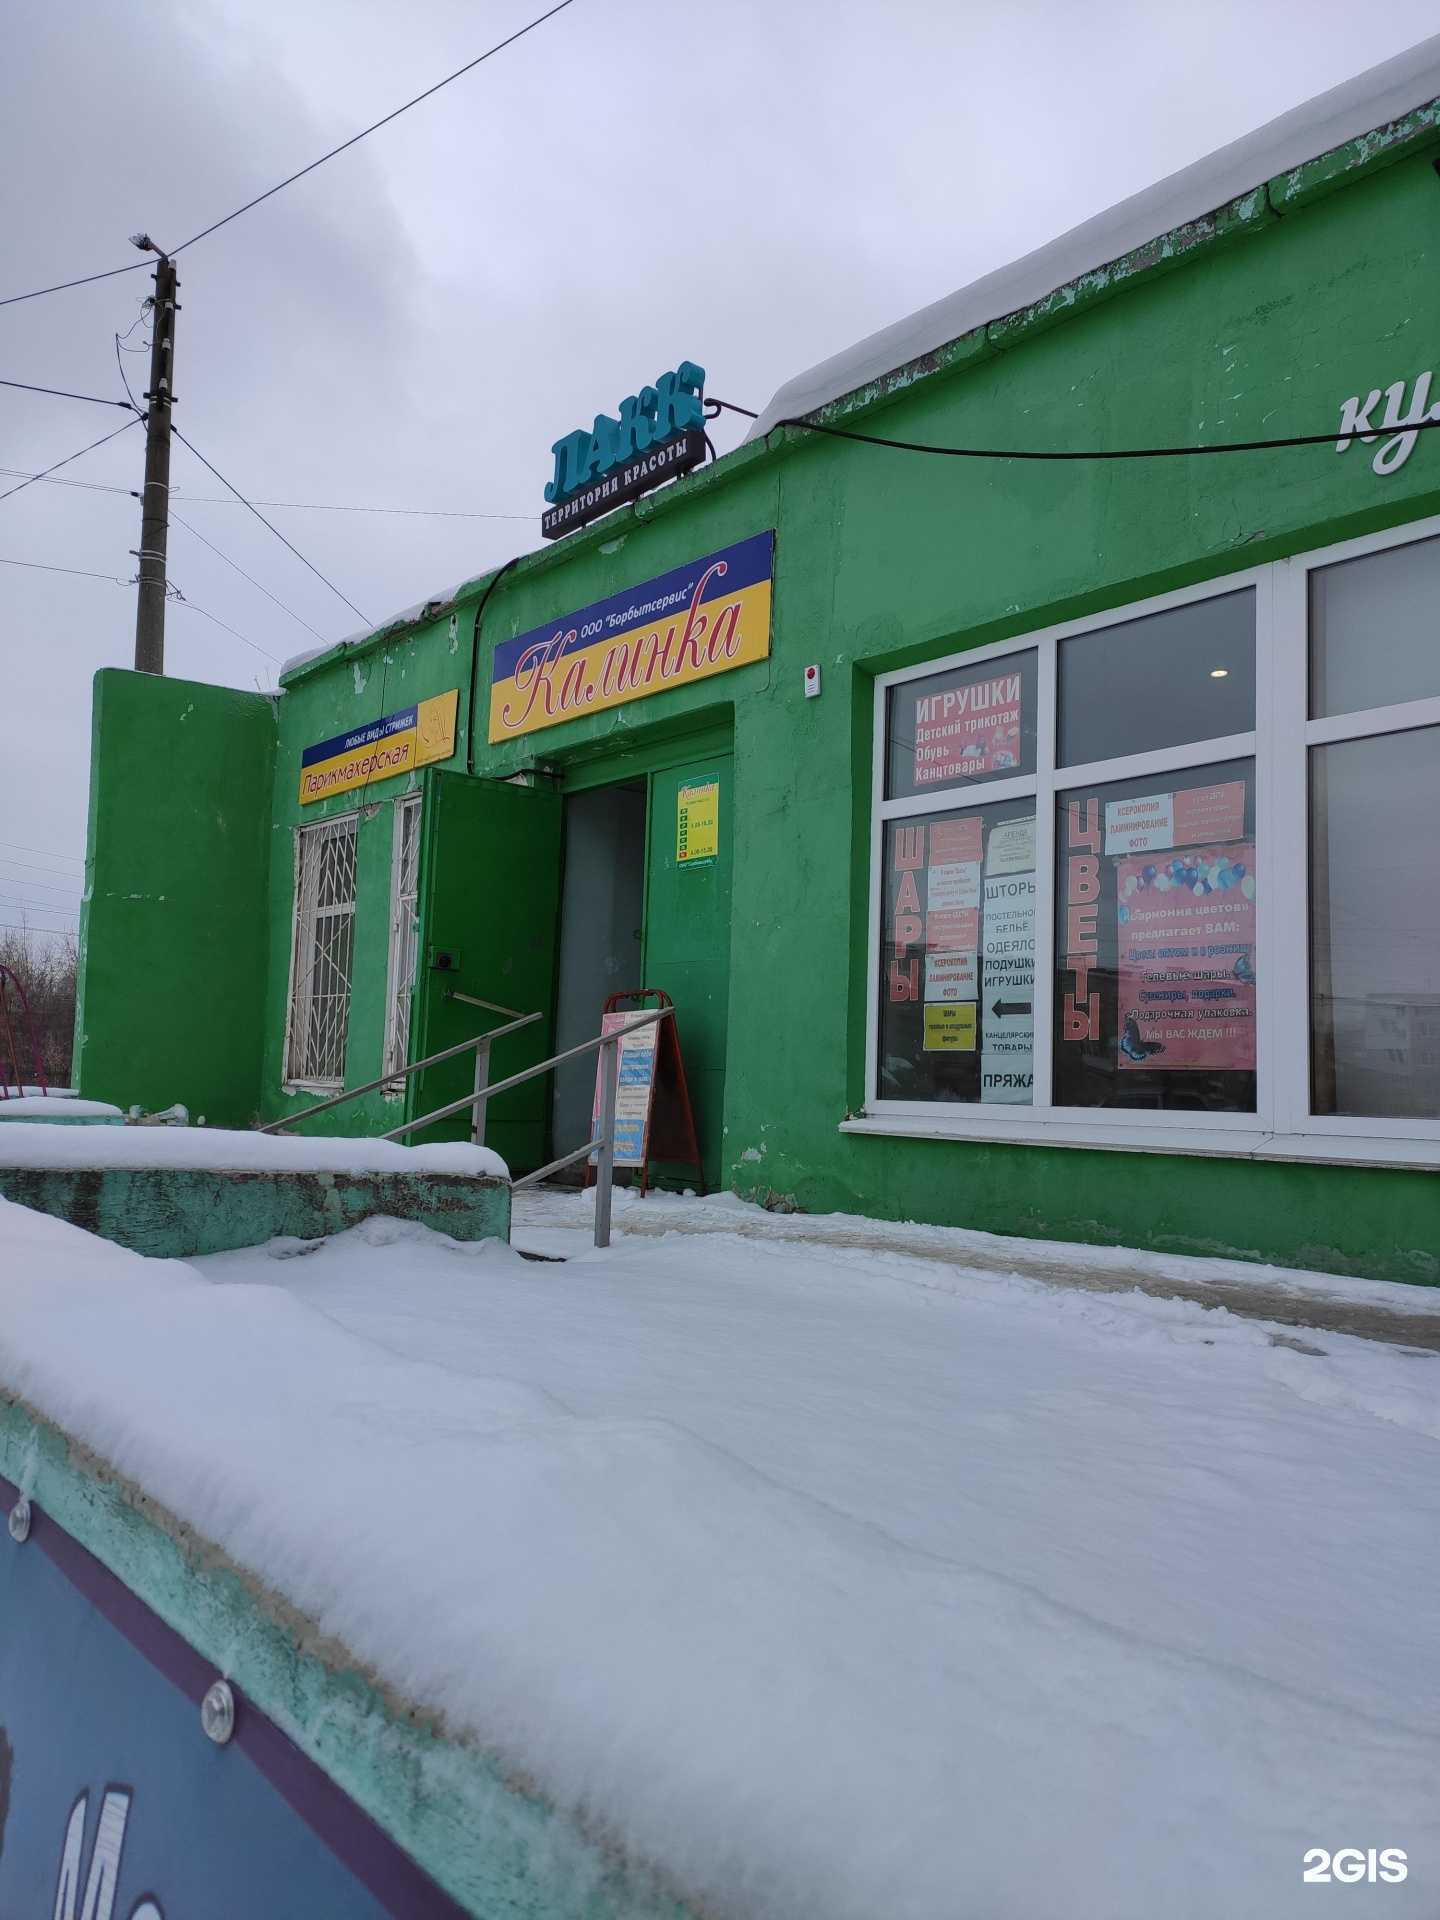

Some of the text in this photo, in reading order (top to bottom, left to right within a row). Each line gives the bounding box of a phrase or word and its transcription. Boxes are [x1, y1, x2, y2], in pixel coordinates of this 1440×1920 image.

[544, 438, 688, 530] ТЕРРИТОРИЯ КРАСОТЫ
[580, 618, 604, 639] ООО
[502, 560, 743, 728] Калинка
[915, 675, 1021, 724] ИГРУШКИ
[344, 714, 415, 750] ЛЮБЫЕ ВИДЫ СТРИЖЕК
[915, 708, 1020, 745] Детский трикотаж
[915, 744, 950, 762] Обувь
[302, 743, 410, 798] Парикмахерская
[915, 757, 985, 782] Канцтовары
[1117, 802, 1160, 817] КСЕРОКОПИЯ
[1110, 817, 1169, 834] ЛАМИНИРОВАНИЕ
[1128, 837, 1148, 848] ФОТО
[889, 825, 925, 1002] ШАРЫ
[1064, 797, 1102, 1041] ЦВЕТЫ
[1131, 921, 1241, 942] предлагает ВАМ:
[942, 987, 958, 997] ФОТО
[1127, 1008, 1194, 1021] Подарочная
[1166, 1028, 1187, 1039] ВАС
[1187, 1027, 1224, 1040] ЖДЕМ
